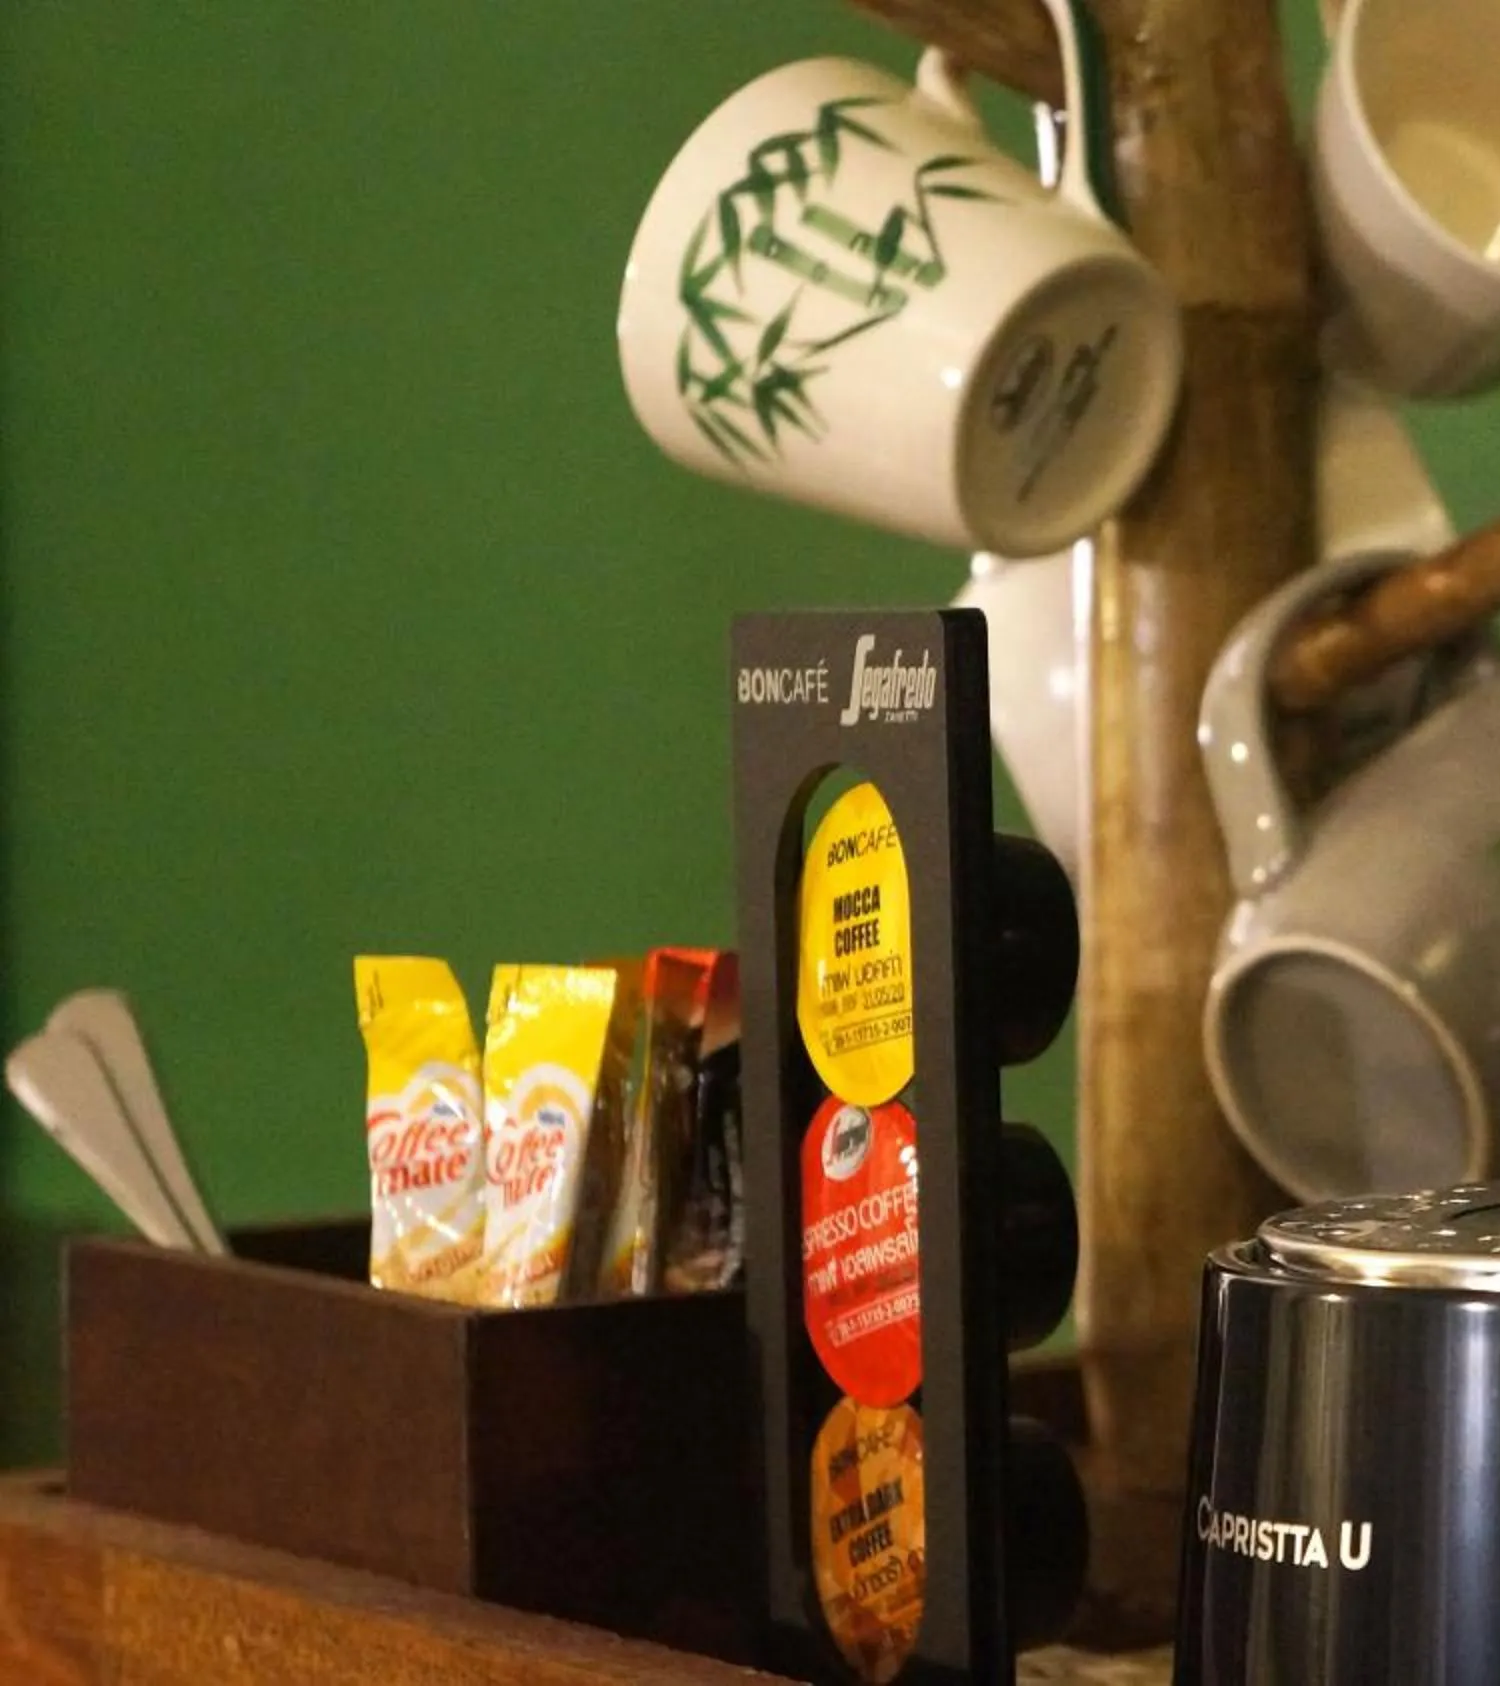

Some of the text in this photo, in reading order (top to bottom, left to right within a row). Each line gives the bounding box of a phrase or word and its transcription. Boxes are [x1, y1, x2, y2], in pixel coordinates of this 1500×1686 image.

[738, 657, 830, 704] BONCAFÉ
[840, 634, 937, 727] Segafredo
[833, 884, 881, 924] MOCCA
[834, 917, 881, 958] COFFEE
[803, 1204, 858, 1261] SPRESSO
[1197, 1494, 1373, 1571] CAPRISTTA U
